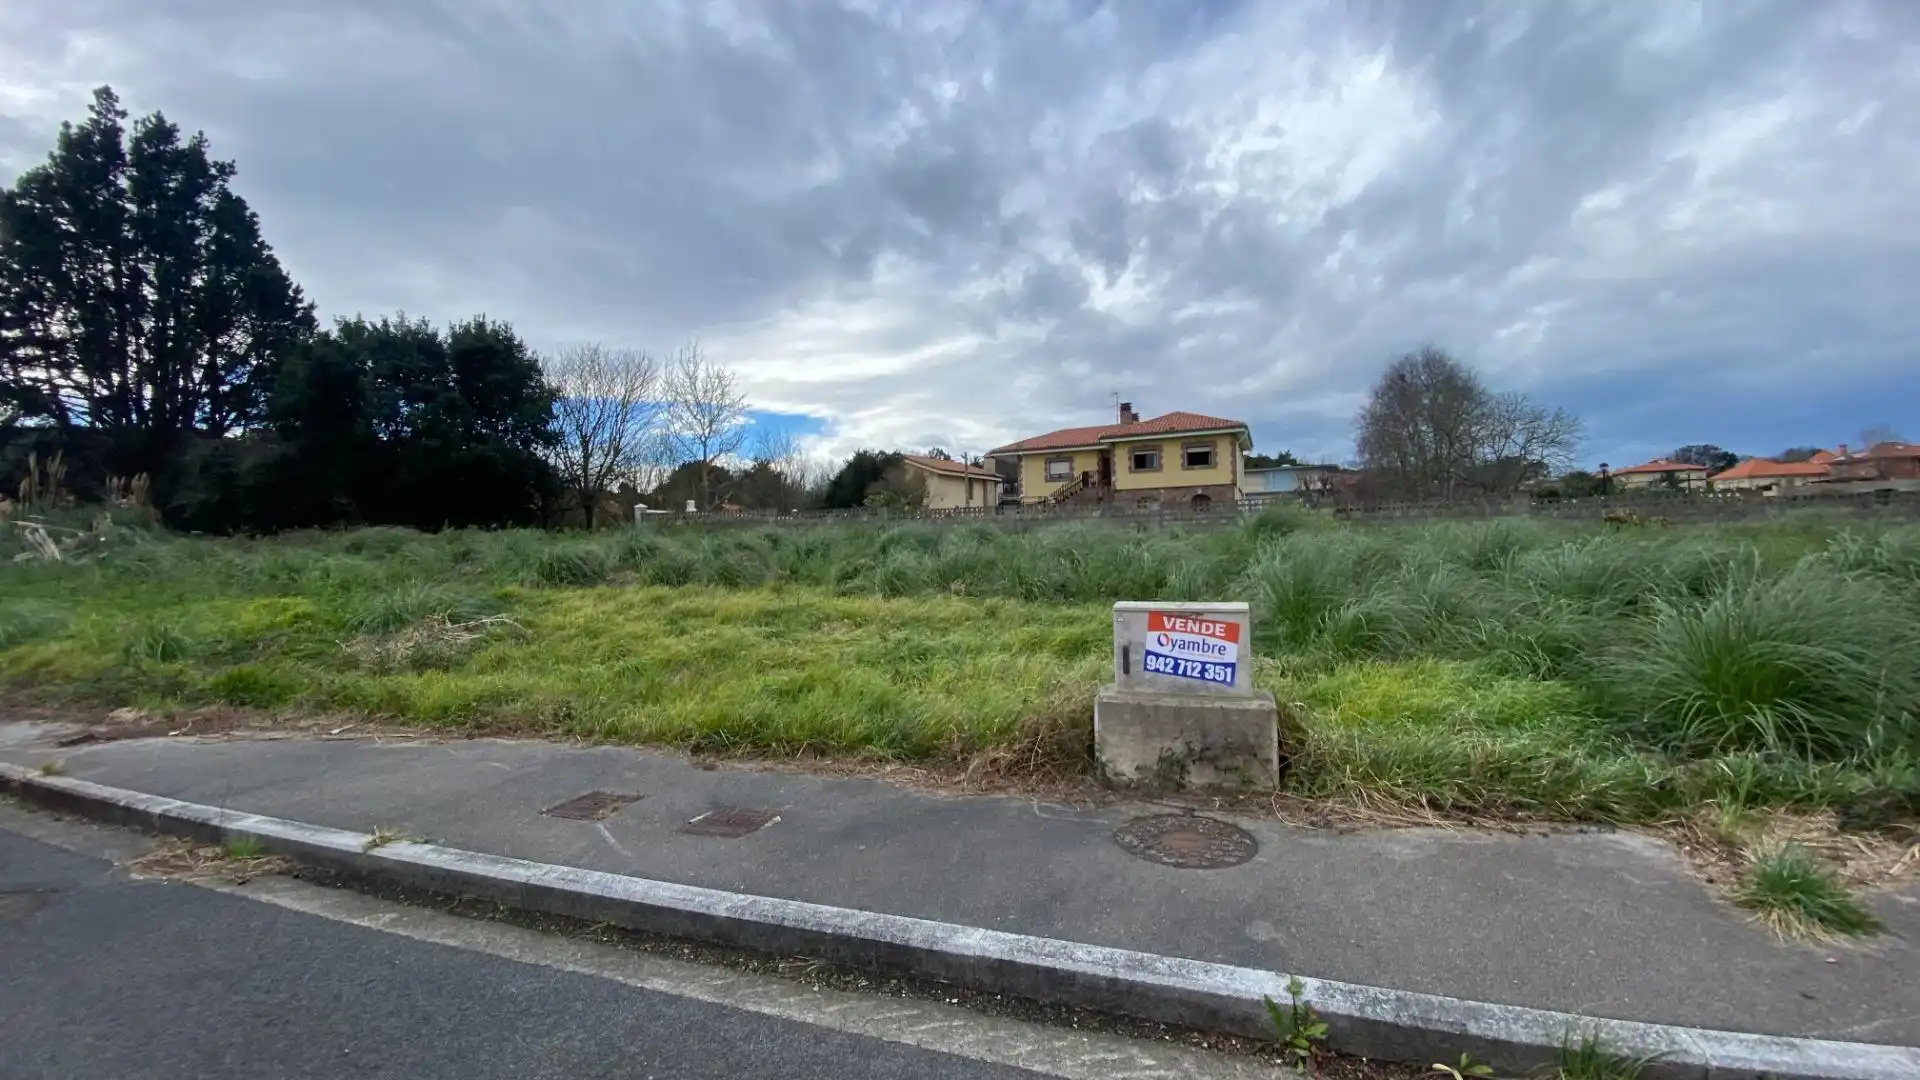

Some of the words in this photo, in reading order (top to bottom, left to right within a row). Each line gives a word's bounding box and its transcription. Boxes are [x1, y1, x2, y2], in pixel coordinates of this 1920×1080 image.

[1162, 616, 1226, 637] VENDE
[1157, 633, 1227, 656] Oyambre
[1146, 655, 1174, 673] 942
[1177, 660, 1201, 677] 712
[1204, 664, 1232, 683] 351
